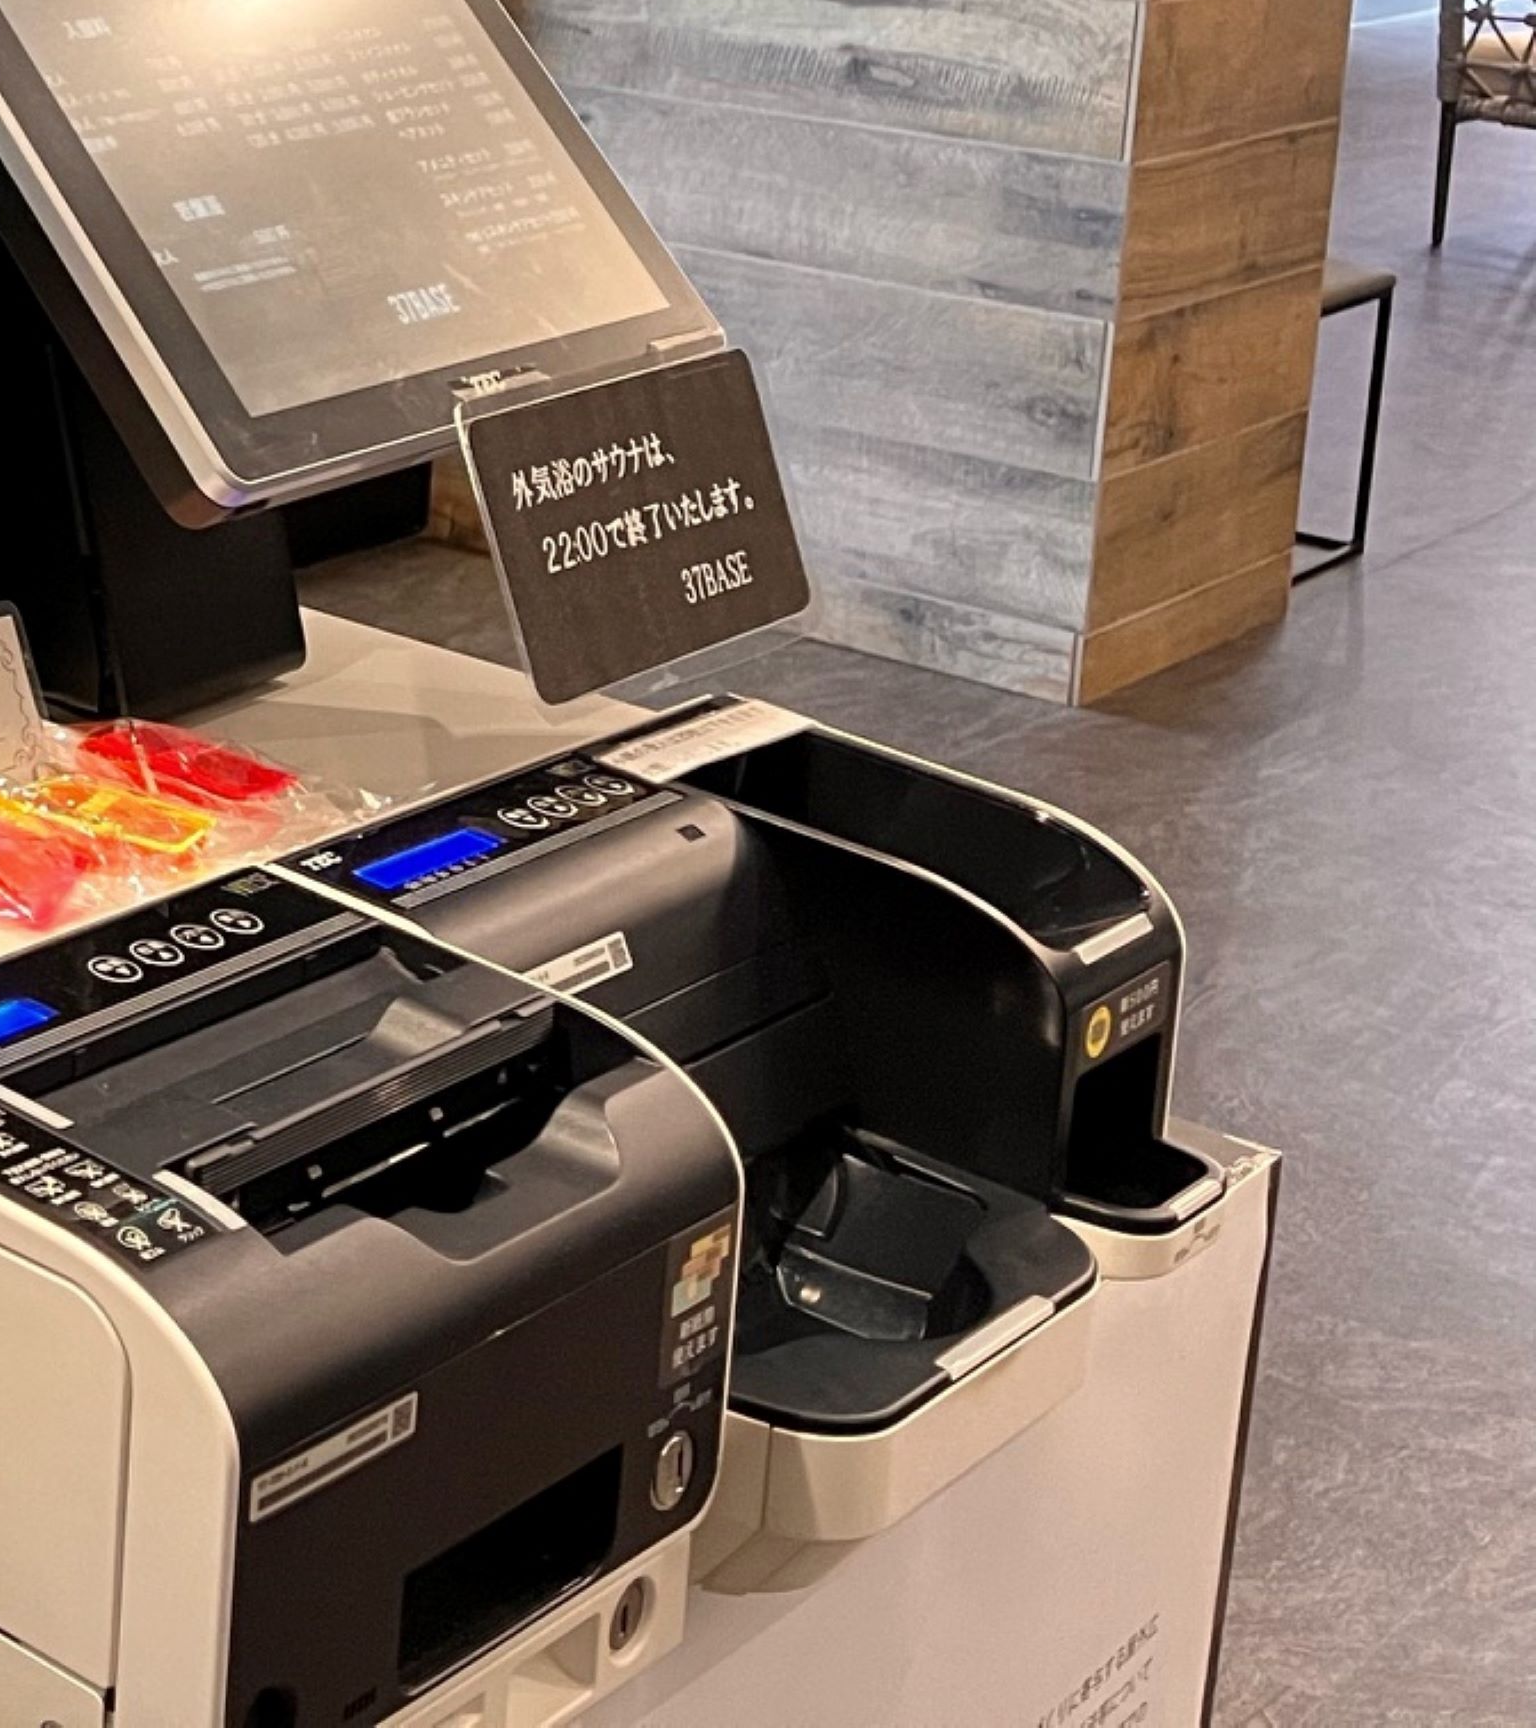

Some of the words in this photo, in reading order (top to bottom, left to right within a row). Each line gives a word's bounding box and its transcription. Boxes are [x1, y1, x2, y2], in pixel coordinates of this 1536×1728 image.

[388, 283, 461, 324] 37BASE
[511, 432, 676, 512] 外気浴のサウナは、
[542, 476, 755, 574] 22:00で終了いたします。
[680, 550, 753, 604] 37BASE
[300, 849, 344, 872] TEC
